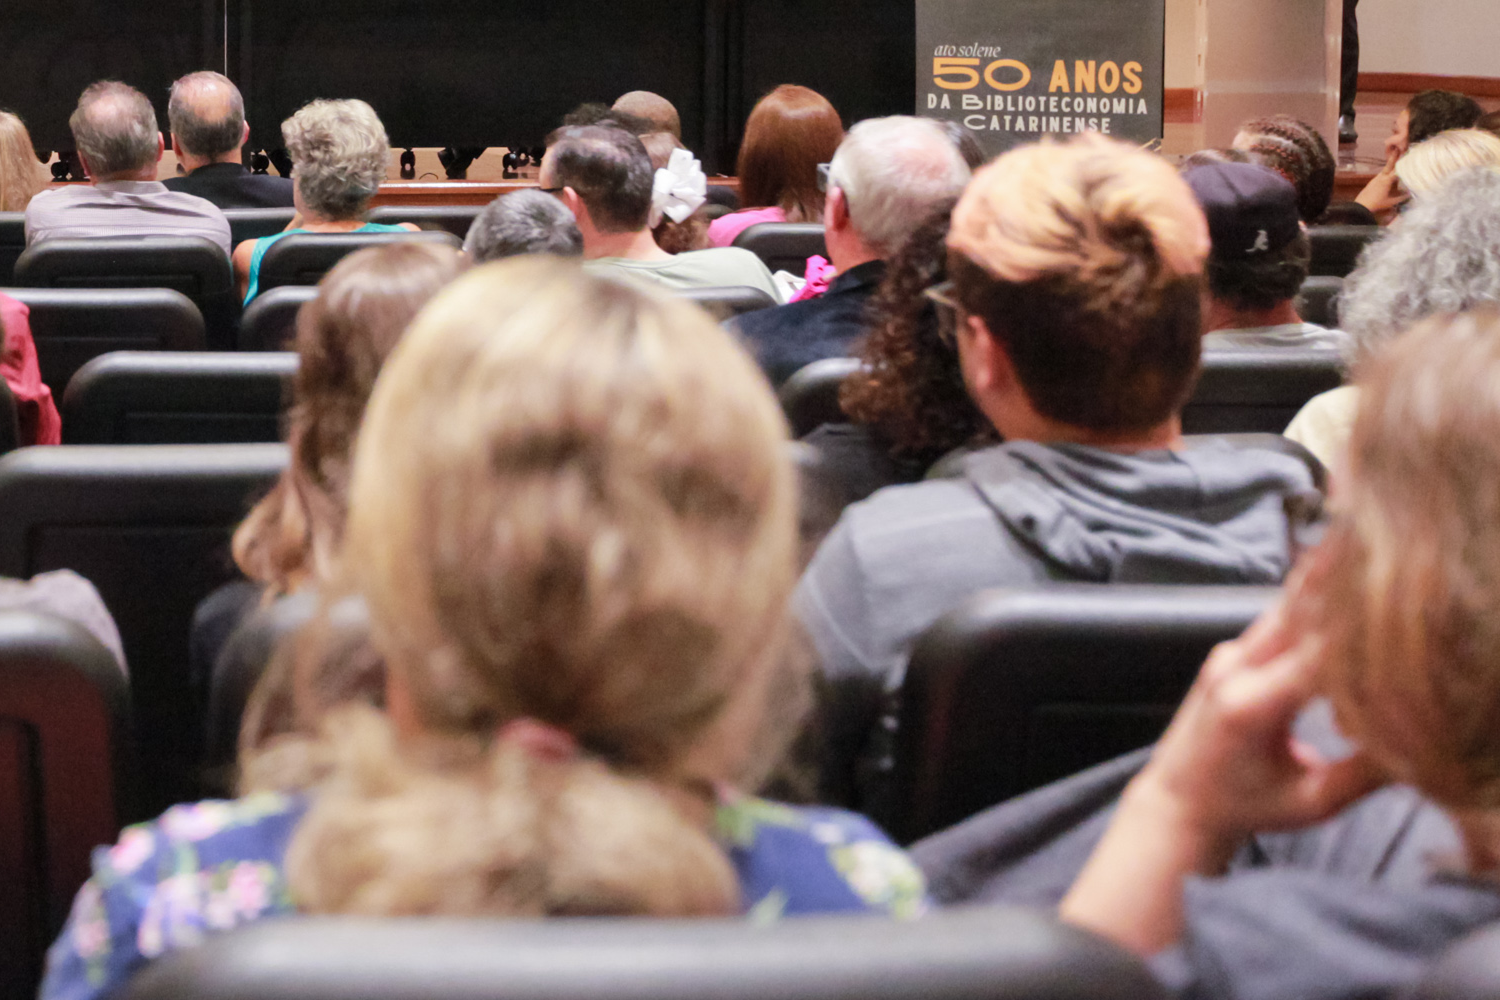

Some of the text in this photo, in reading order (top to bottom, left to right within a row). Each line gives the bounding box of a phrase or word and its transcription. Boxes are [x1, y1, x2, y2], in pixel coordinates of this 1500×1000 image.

[934, 42, 1001, 58] ato solene
[933, 57, 1143, 94] 50 ANOS
[927, 93, 1148, 115] DA BIBLIOTECONOMIA
[963, 114, 1111, 134] CATARINENSE
